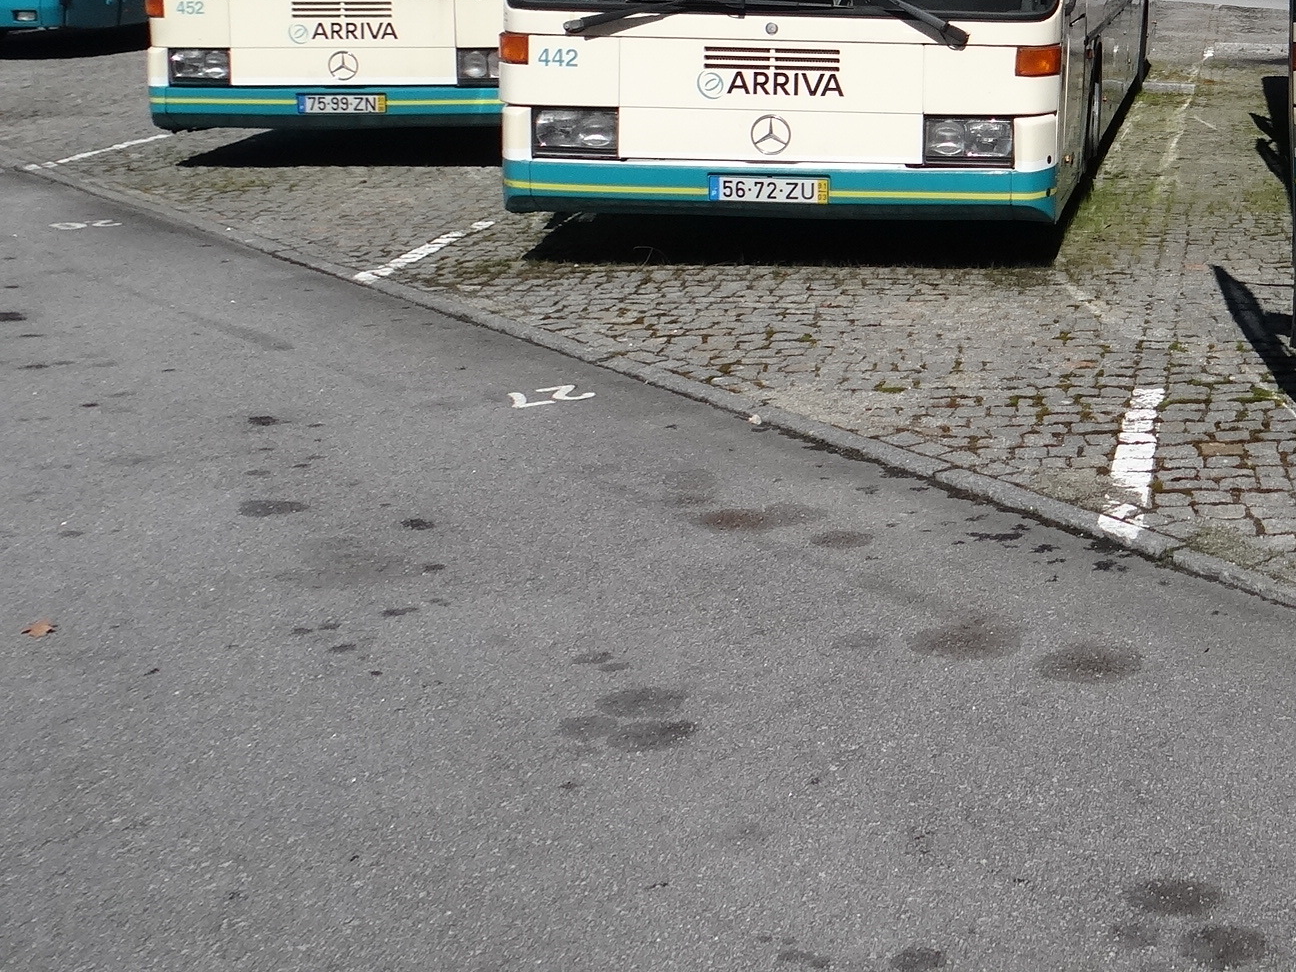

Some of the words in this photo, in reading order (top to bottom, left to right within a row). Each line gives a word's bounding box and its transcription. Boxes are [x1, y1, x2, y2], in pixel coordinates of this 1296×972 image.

[176, 1, 205, 15] 452
[311, 22, 399, 40] ARRIVA
[538, 48, 579, 67] 442
[727, 71, 844, 97] ARRIVA
